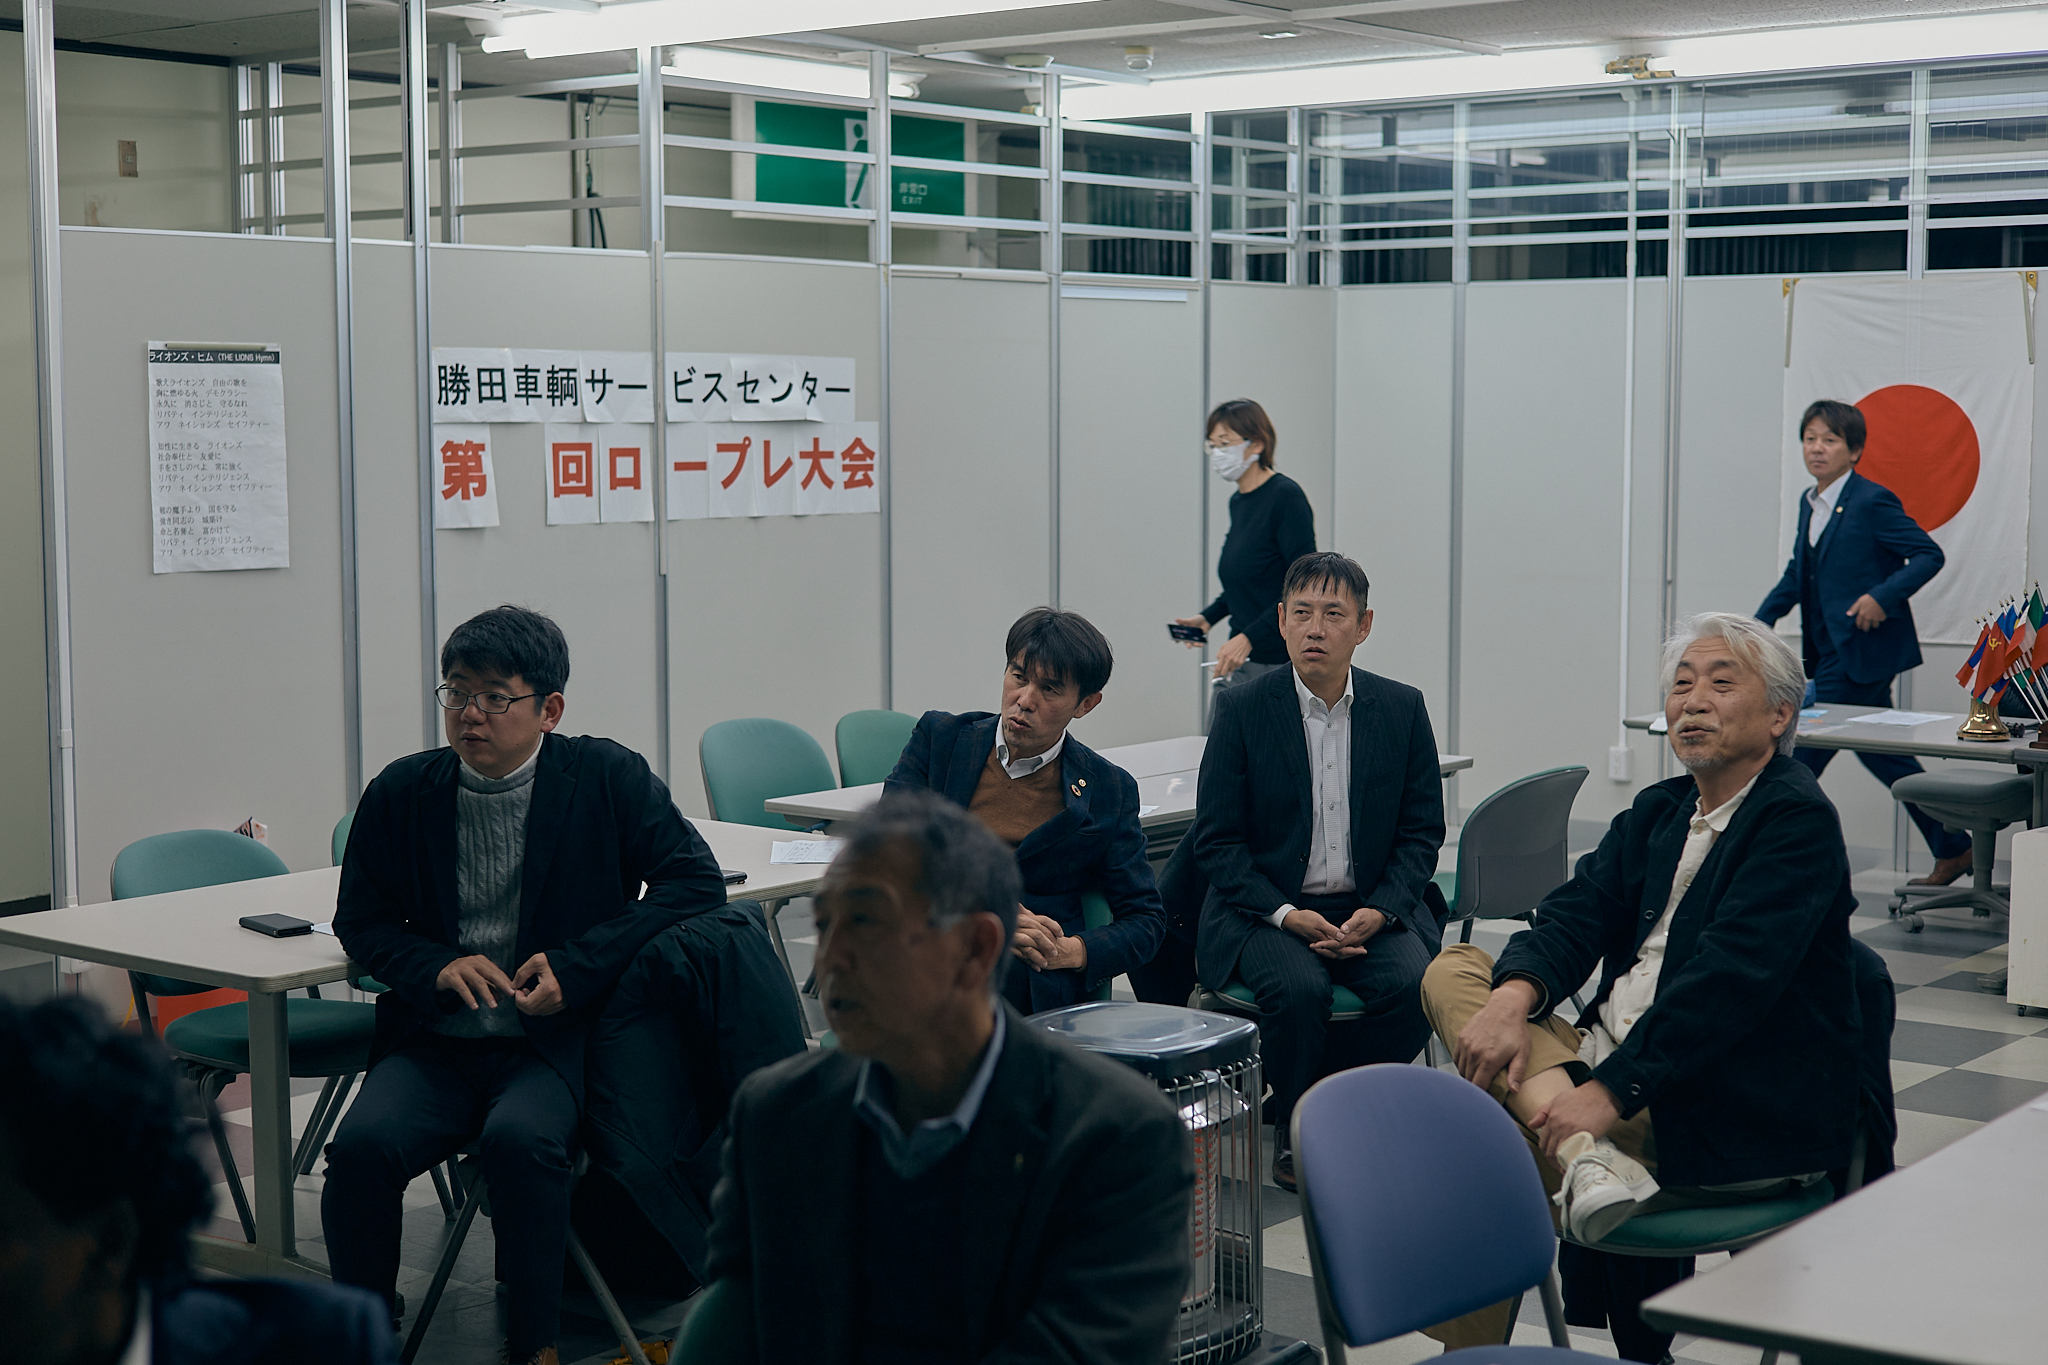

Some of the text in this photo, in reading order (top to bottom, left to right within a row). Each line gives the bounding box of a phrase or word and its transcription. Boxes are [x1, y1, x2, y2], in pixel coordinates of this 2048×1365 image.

[899, 183, 927, 195] 非常口
[902, 196, 922, 204] EXIT
[150, 351, 214, 362] ライオンズ・ヒム
[235, 353, 253, 362] LIONS
[213, 379, 247, 387] 自由の歌を
[206, 389, 247, 397] デモクラシー
[156, 400, 177, 408] 永久に
[158, 442, 242, 450] 知性に生きる ライオンズ
[158, 453, 192, 461] 社会奉仕と
[441, 439, 487, 501] 第
[208, 505, 237, 513] 国を守る
[196, 536, 252, 545] インテリジェンス
